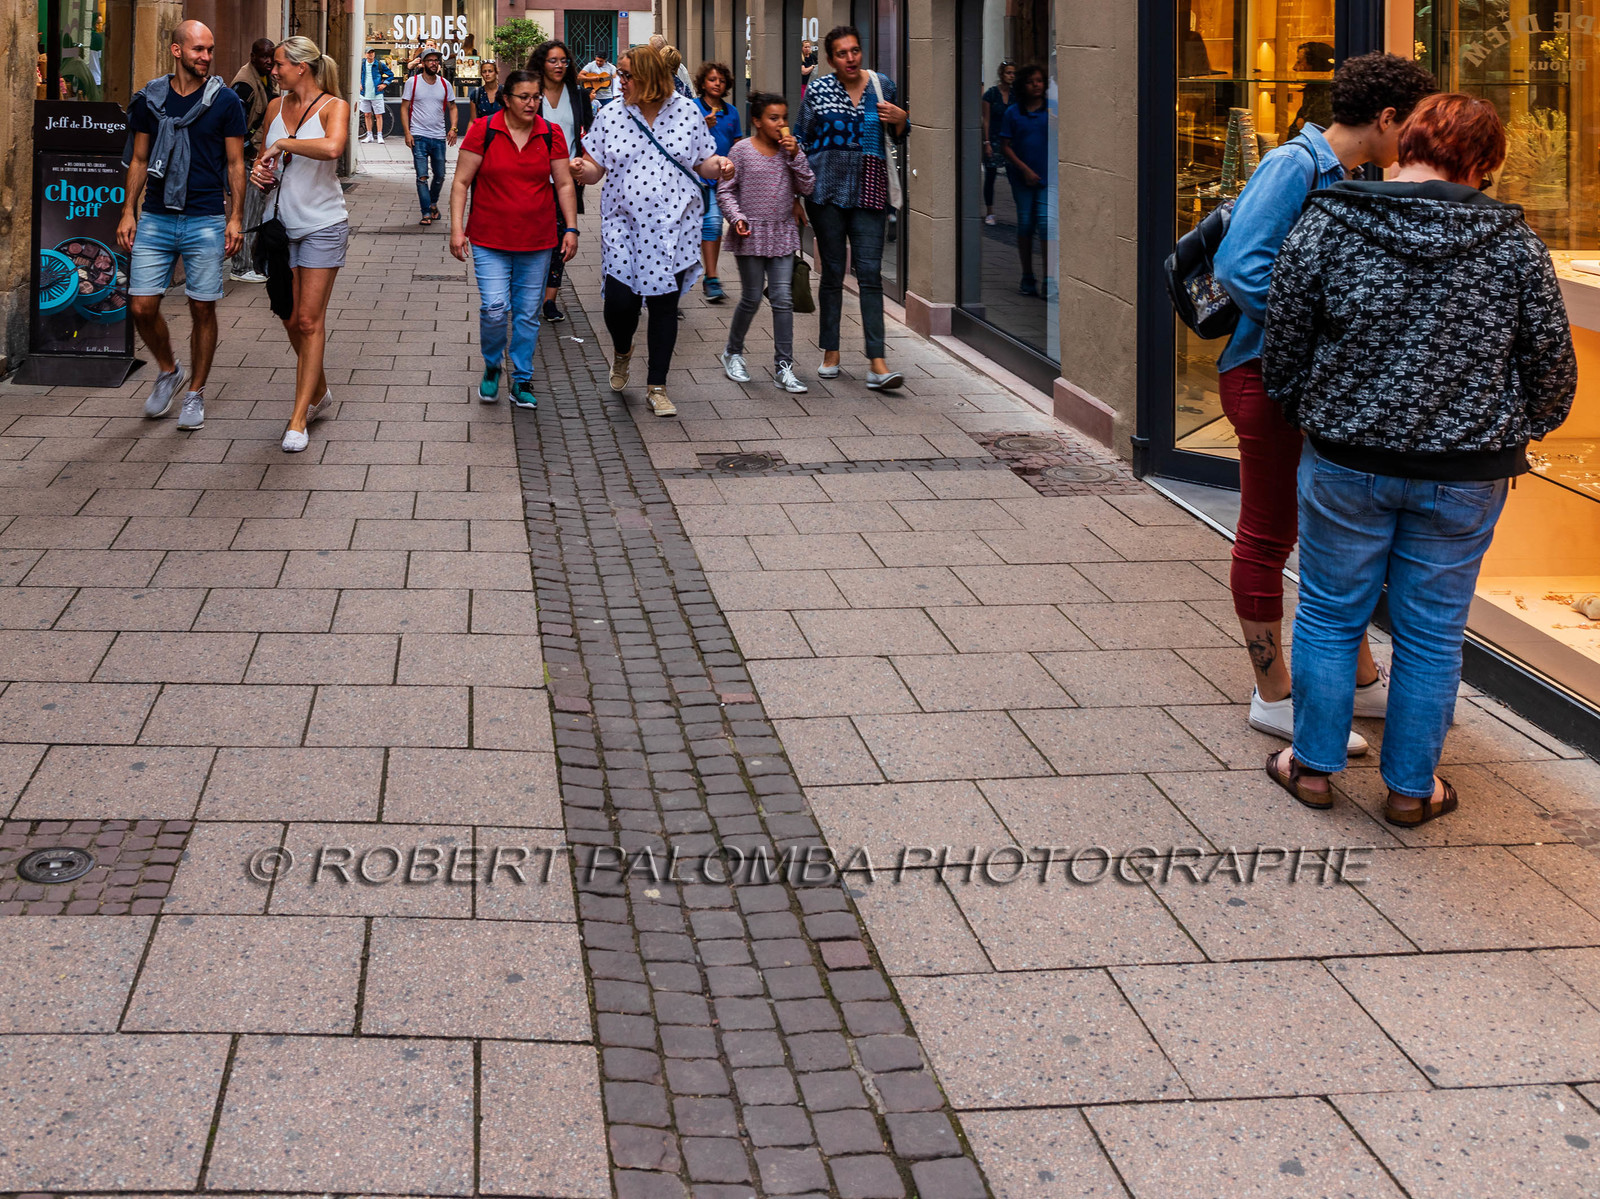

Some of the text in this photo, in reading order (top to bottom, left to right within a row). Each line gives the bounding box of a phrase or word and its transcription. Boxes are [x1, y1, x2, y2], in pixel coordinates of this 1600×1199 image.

[393, 14, 468, 41] SOLDES
[45, 115, 127, 134] Jeff de Bruges
[44, 179, 126, 204] choco
[65, 202, 103, 221] jeff
